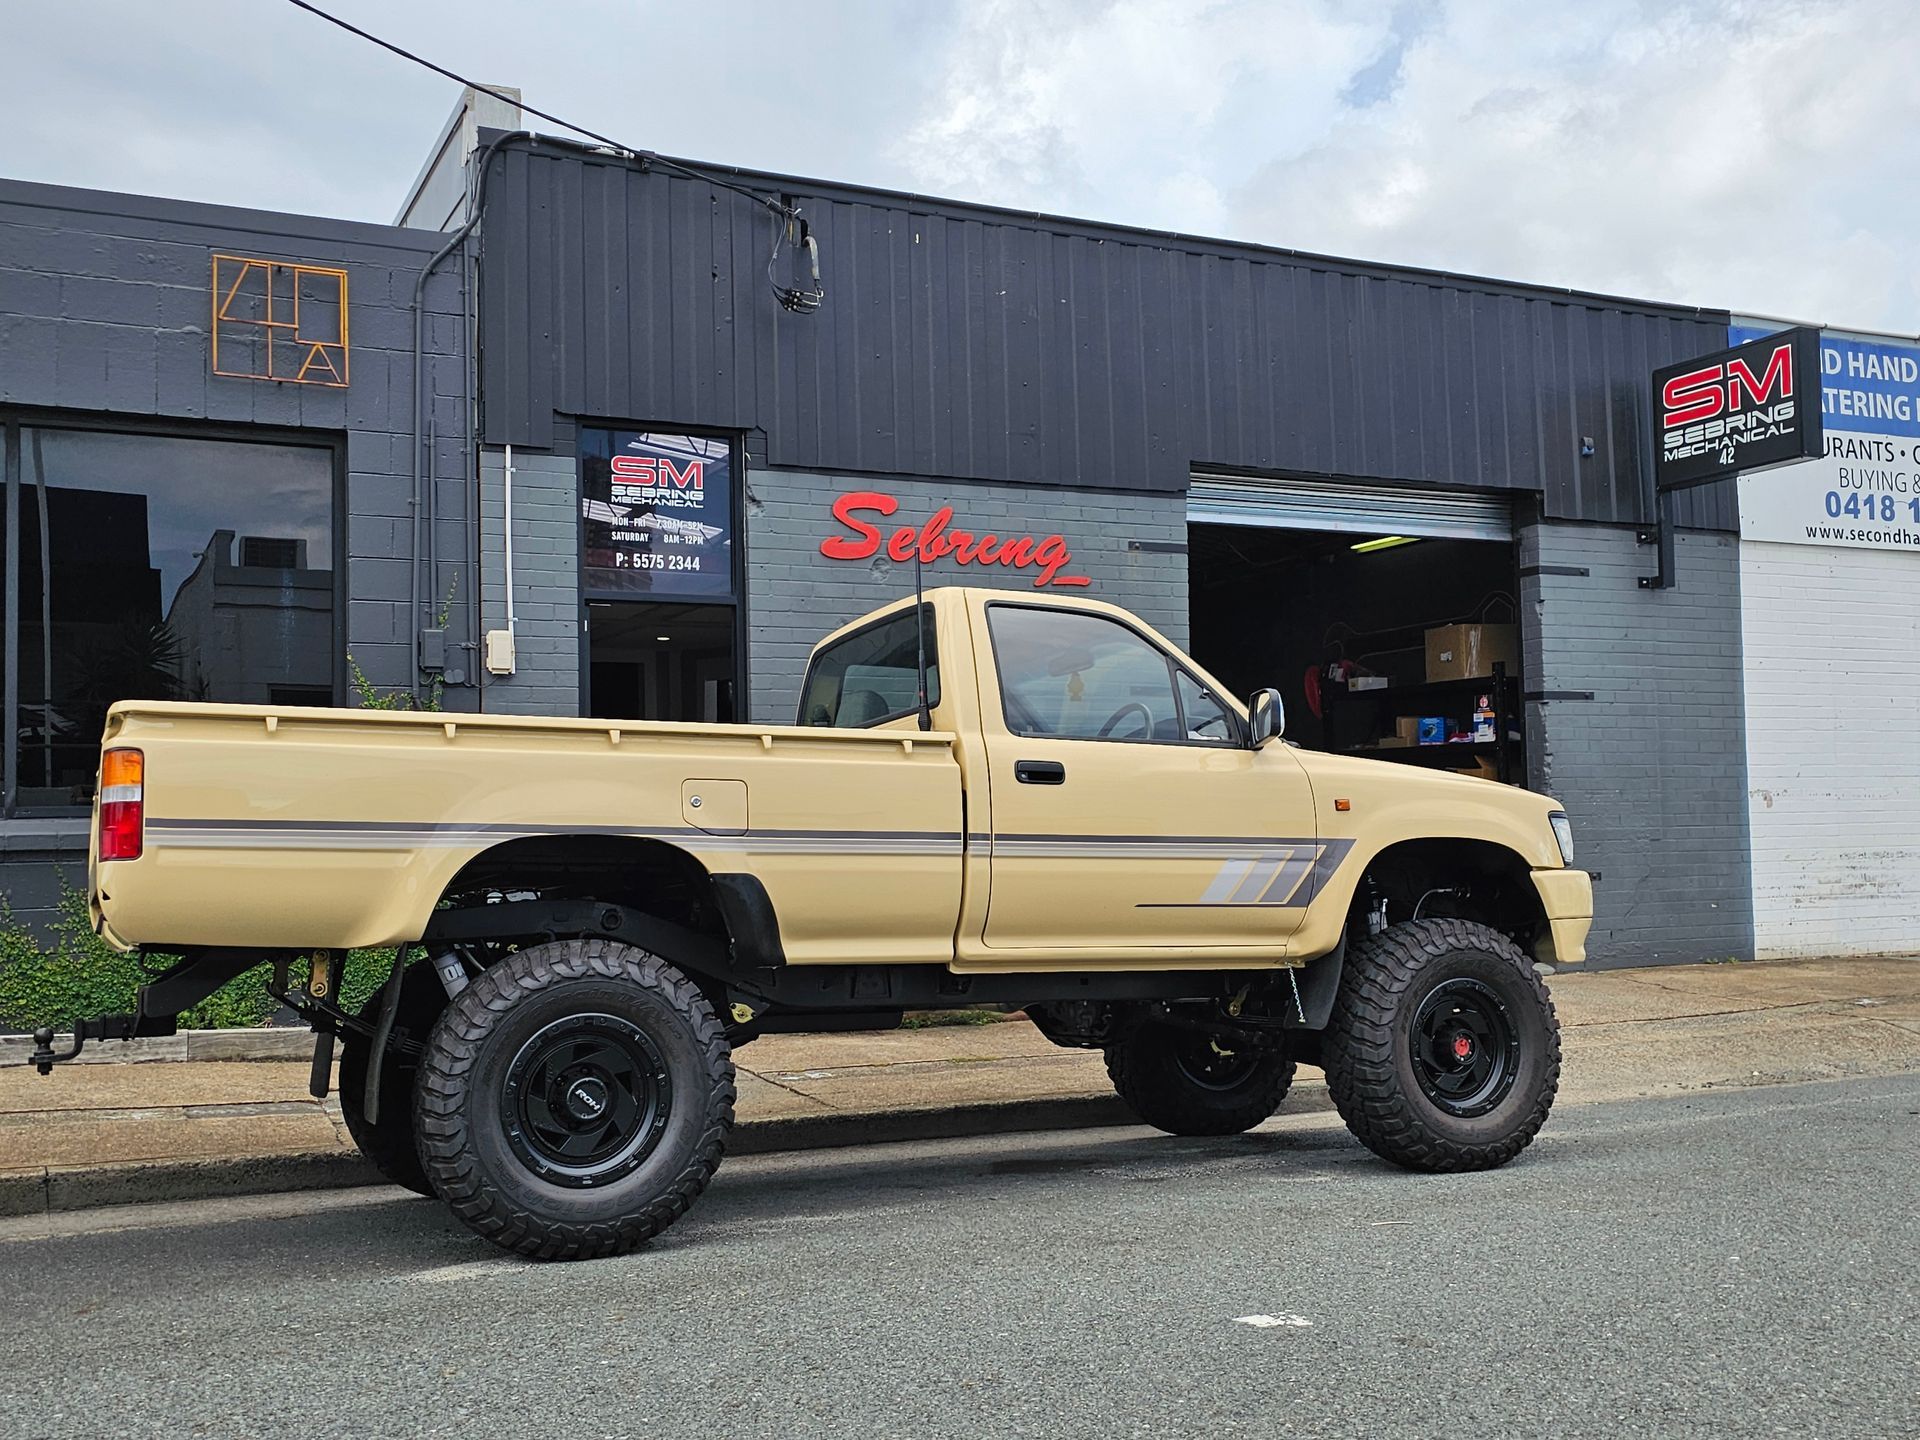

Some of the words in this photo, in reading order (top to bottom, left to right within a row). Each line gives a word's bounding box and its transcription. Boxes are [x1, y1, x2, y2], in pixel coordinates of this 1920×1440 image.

[1847, 351, 1918, 383] HAND
[1664, 401, 1795, 449] SEBRING
[1664, 423, 1795, 462] MECHANICAL
[1719, 448, 1735, 465] 42
[1839, 467, 1907, 493] BUYING
[611, 485, 704, 501] SEBRING
[611, 495, 704, 509] MECHANICAL
[1825, 491, 1896, 522] 0418
[611, 531, 650, 542] SATURDAY
[663, 534, 704, 546] 8AM-12PM
[820, 492, 1092, 587] Sebring
[615, 552, 629, 568] P:
[633, 553, 665, 570] 5575
[668, 555, 700, 572] 2344
[575, 1089, 601, 1110] ROH
